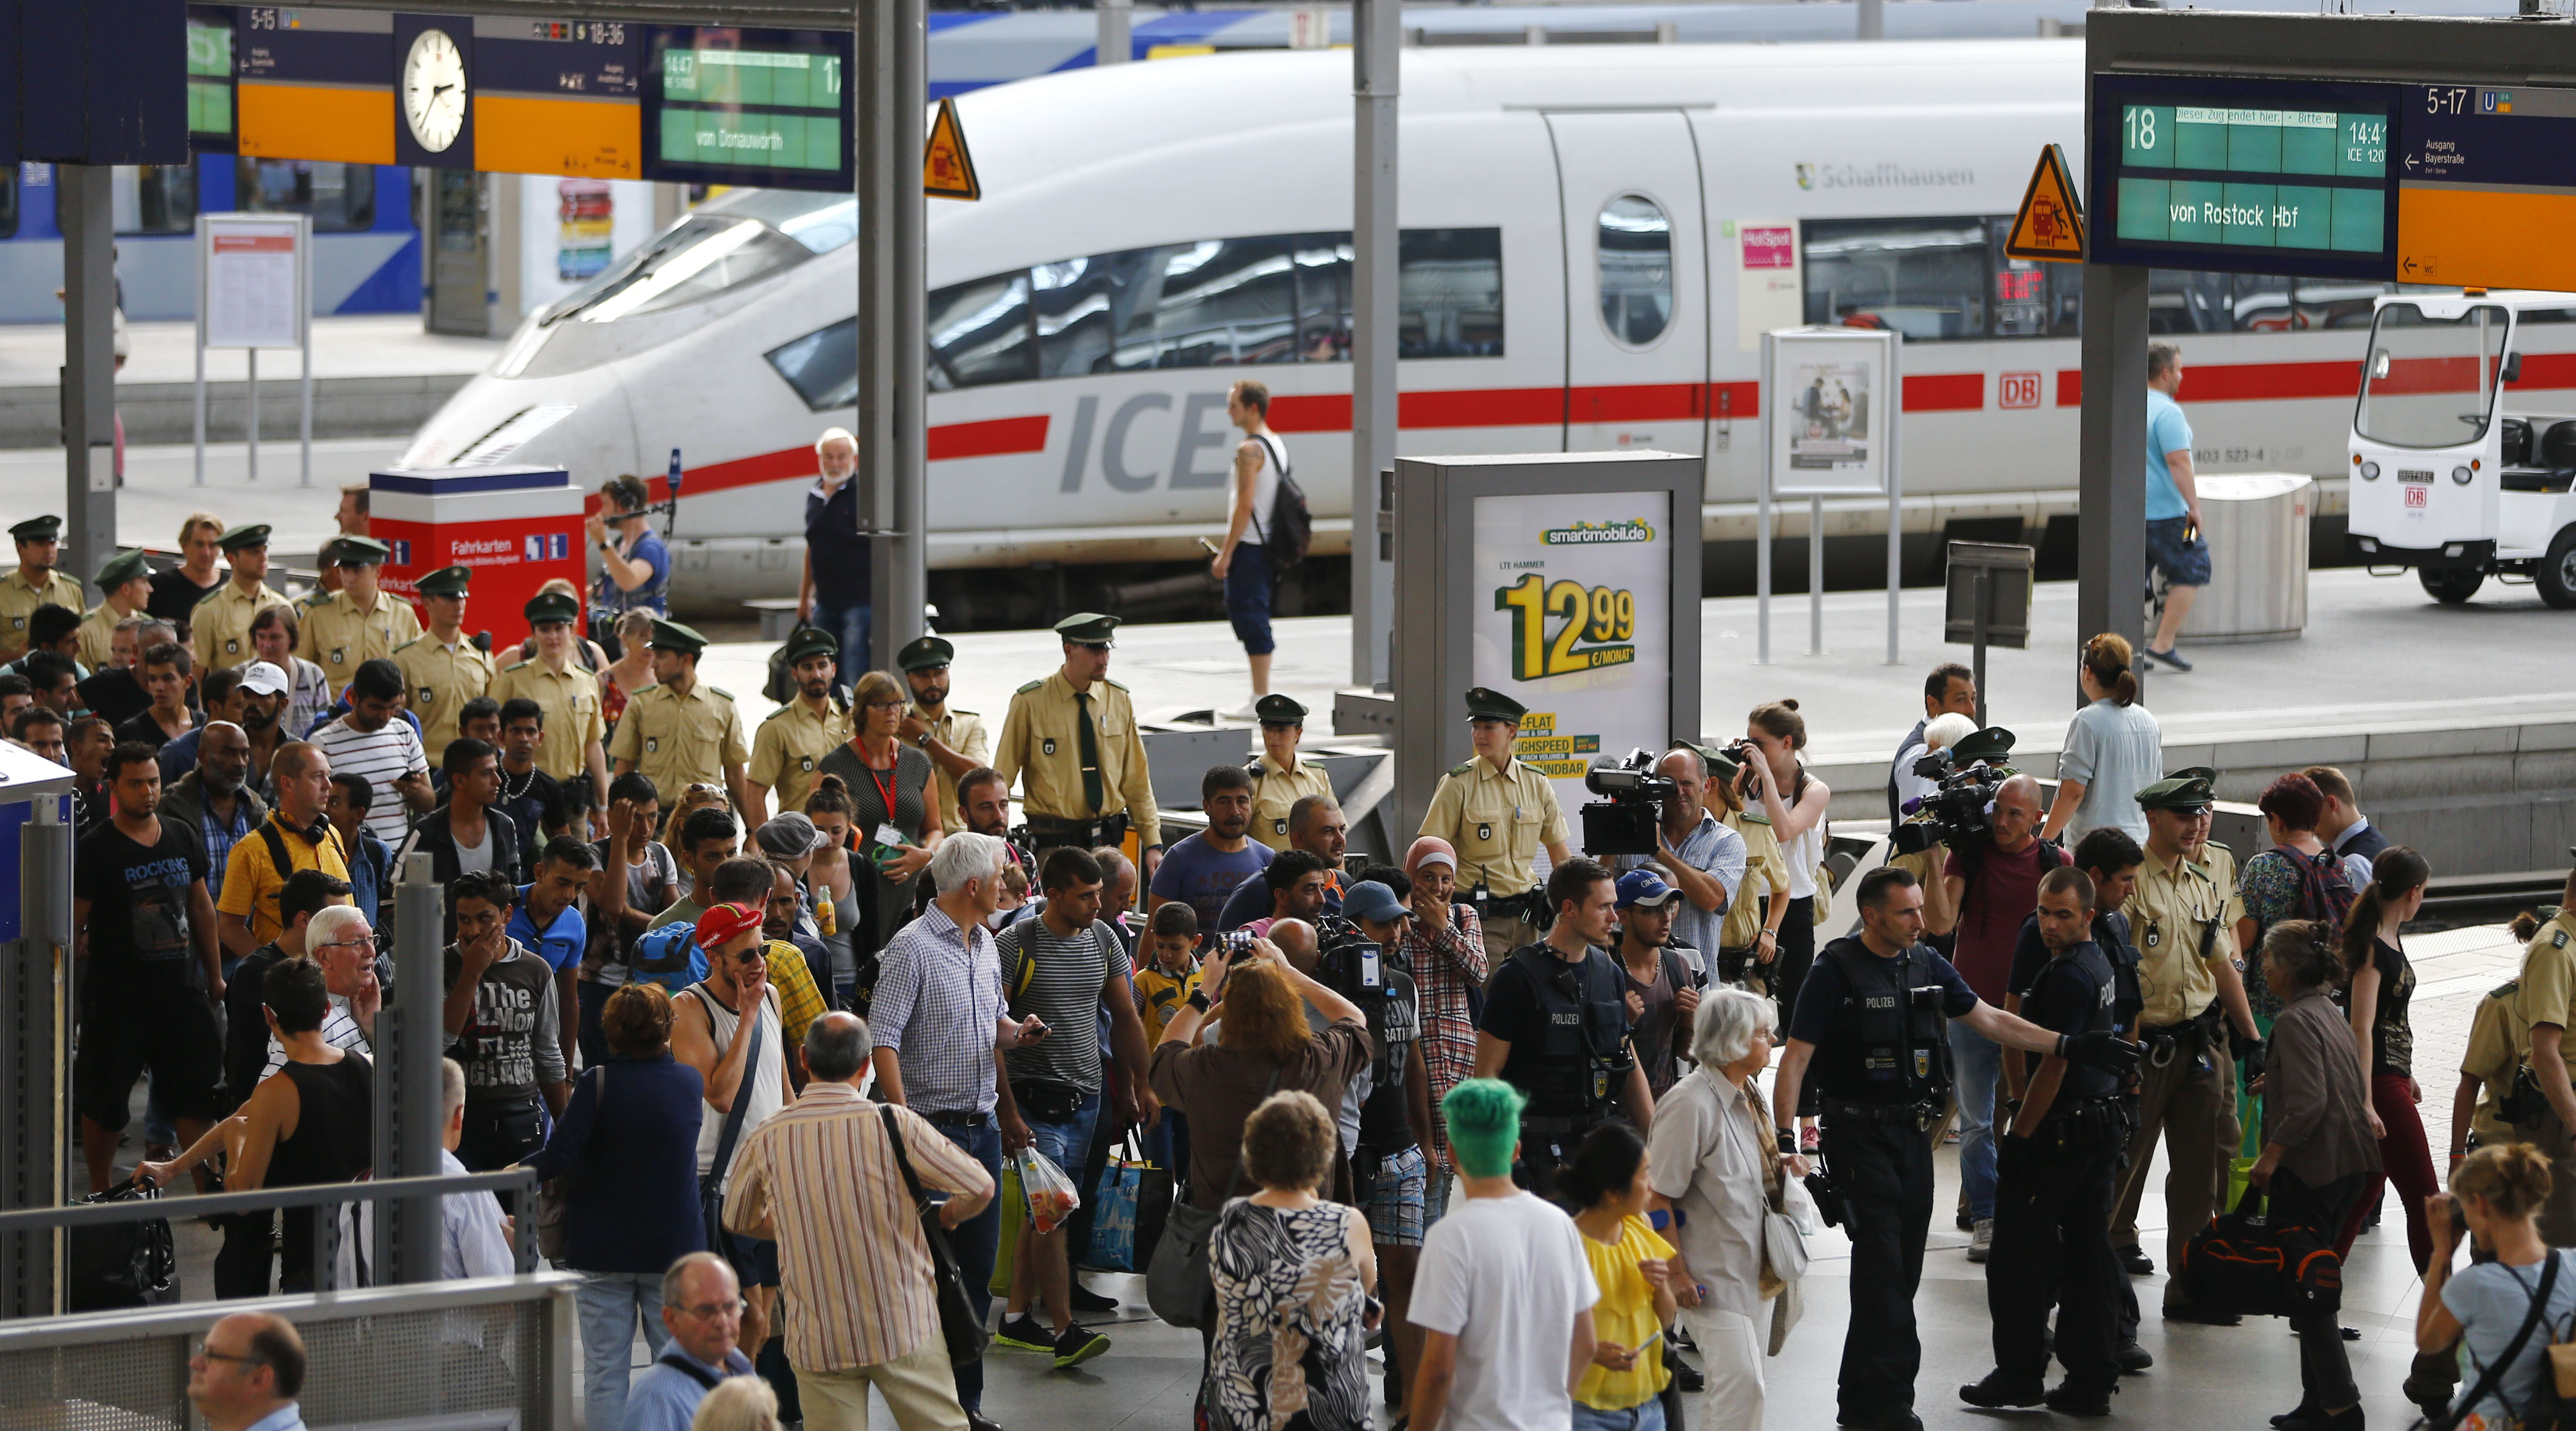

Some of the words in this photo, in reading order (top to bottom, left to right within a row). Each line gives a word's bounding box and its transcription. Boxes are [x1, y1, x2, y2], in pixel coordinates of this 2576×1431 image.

[251, 8, 276, 30] 5-15
[590, 22, 624, 45] 18-36
[2427, 88, 2467, 115] 5-17
[2485, 93, 2494, 110] U
[2175, 108, 2204, 120] Dieser
[2208, 109, 2225, 122] Zug
[2228, 110, 2256, 122] endet
[2259, 112, 2281, 123] hier.
[2298, 113, 2319, 124] Bitte
[2125, 107, 2155, 150] 18
[696, 131, 716, 147] von
[718, 128, 783, 150] Donauwörth
[2426, 139, 2455, 152] Ausgang
[2348, 148, 2362, 162] ICE
[2368, 149, 2386, 163] 120
[2425, 153, 2464, 165] Bayerstraße
[1821, 163, 1976, 189] Schaffhausen
[2170, 205, 2196, 223] von
[2205, 202, 2264, 226] Rostock
[2272, 205, 2298, 228] Hbf
[2004, 378, 2036, 403] DB
[1060, 393, 1230, 495] ICE
[2225, 446, 2264, 464] 523-4
[2408, 490, 2424, 506] DB
[1549, 525, 1646, 544] smartmobil.de
[451, 539, 512, 555] Fahrkarten
[1499, 561, 1512, 570] LTE
[1513, 560, 1545, 570] HAMMER
[379, 577, 420, 593] ahrkart
[1519, 717, 1552, 728] -FLAT
[124, 858, 189, 883] ROCKING
[165, 871, 191, 888] OUT
[483, 982, 530, 1009] The
[1866, 996, 1895, 1009] POLIZEI
[1552, 1013, 1579, 1025] POLIZEI
